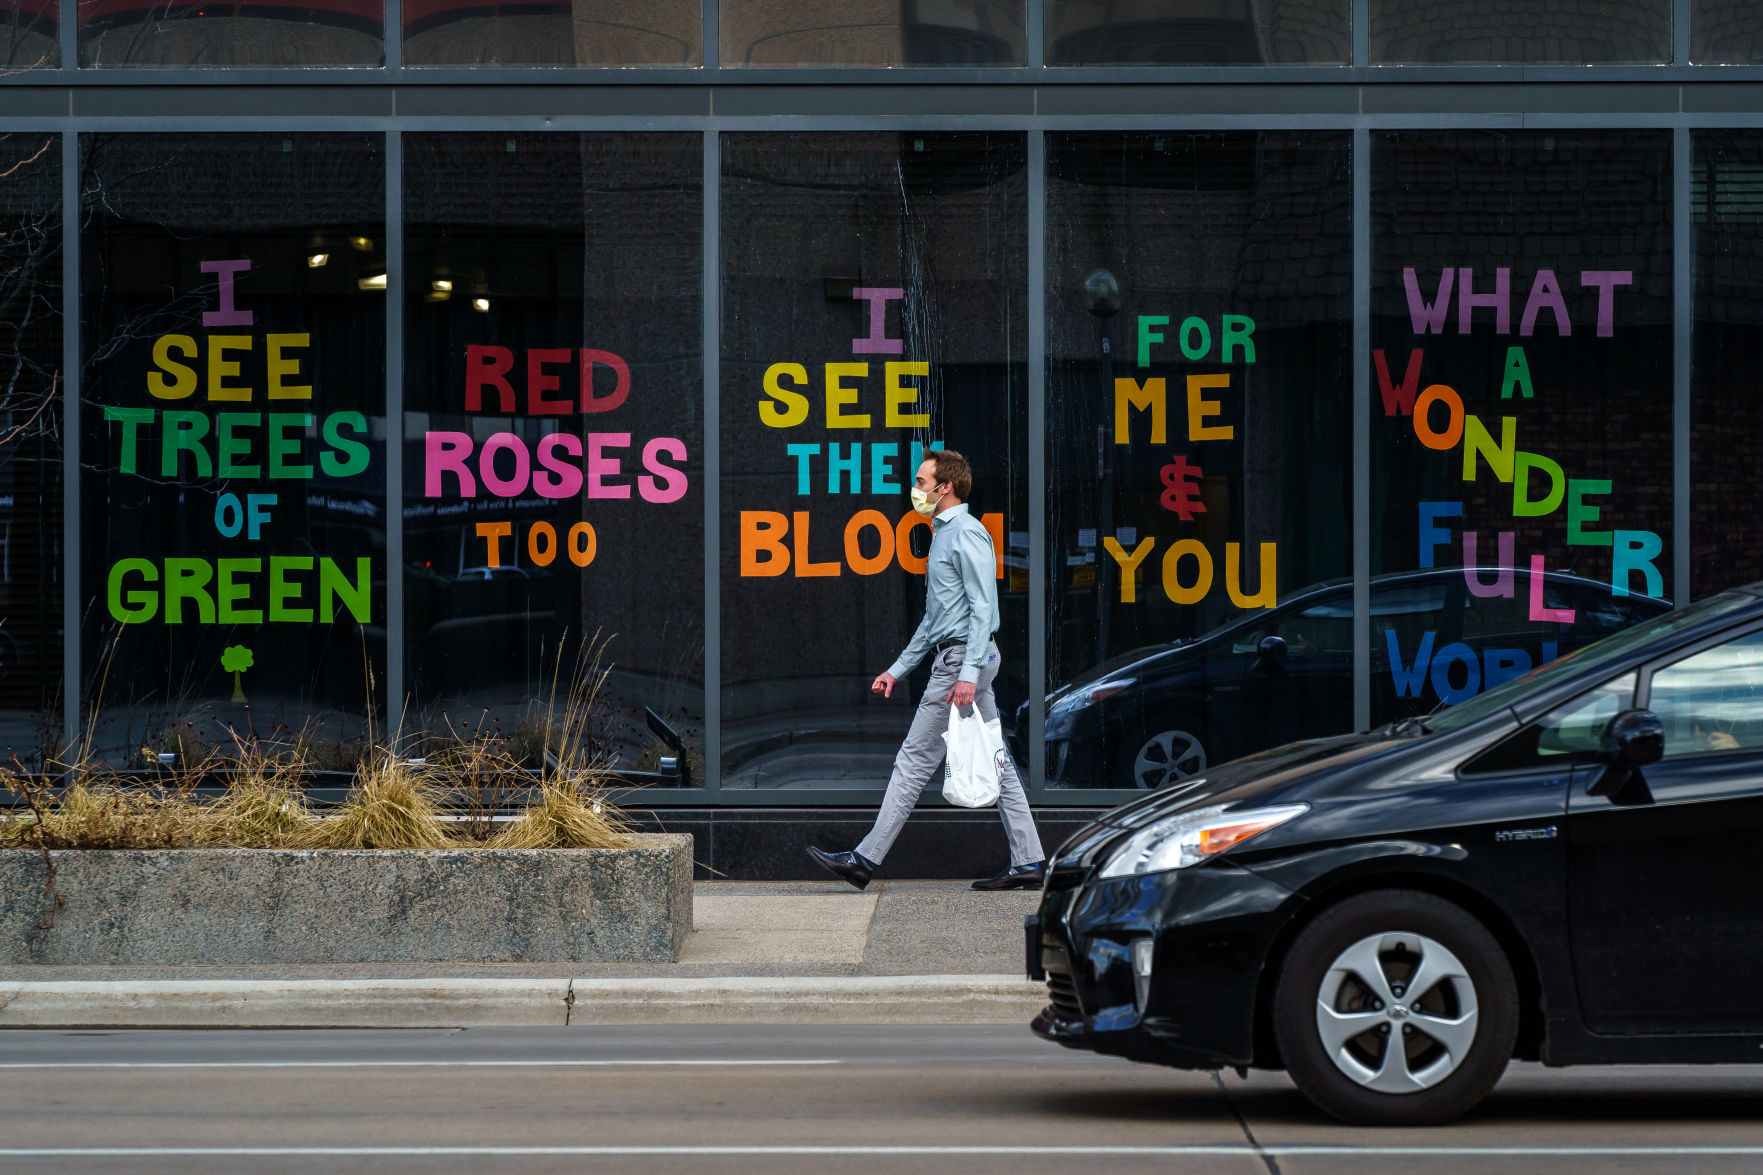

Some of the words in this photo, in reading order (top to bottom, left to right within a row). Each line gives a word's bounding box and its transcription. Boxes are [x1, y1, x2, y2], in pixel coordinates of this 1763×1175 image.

[200, 259, 253, 327] I
[852, 287, 904, 354] I
[1403, 267, 1633, 337] WHAT
[147, 333, 312, 401] SEE
[1137, 314, 1256, 367] FOR
[1501, 346, 1534, 399] A
[464, 345, 631, 415] RED
[758, 362, 930, 428] SEE
[1114, 374, 1234, 445] ME
[104, 407, 370, 479] TREES
[425, 431, 689, 503] ROSES
[214, 493, 278, 540] OF
[475, 521, 597, 568] TOO
[107, 556, 371, 624] GREEN
[1104, 536, 1277, 609] YOU
